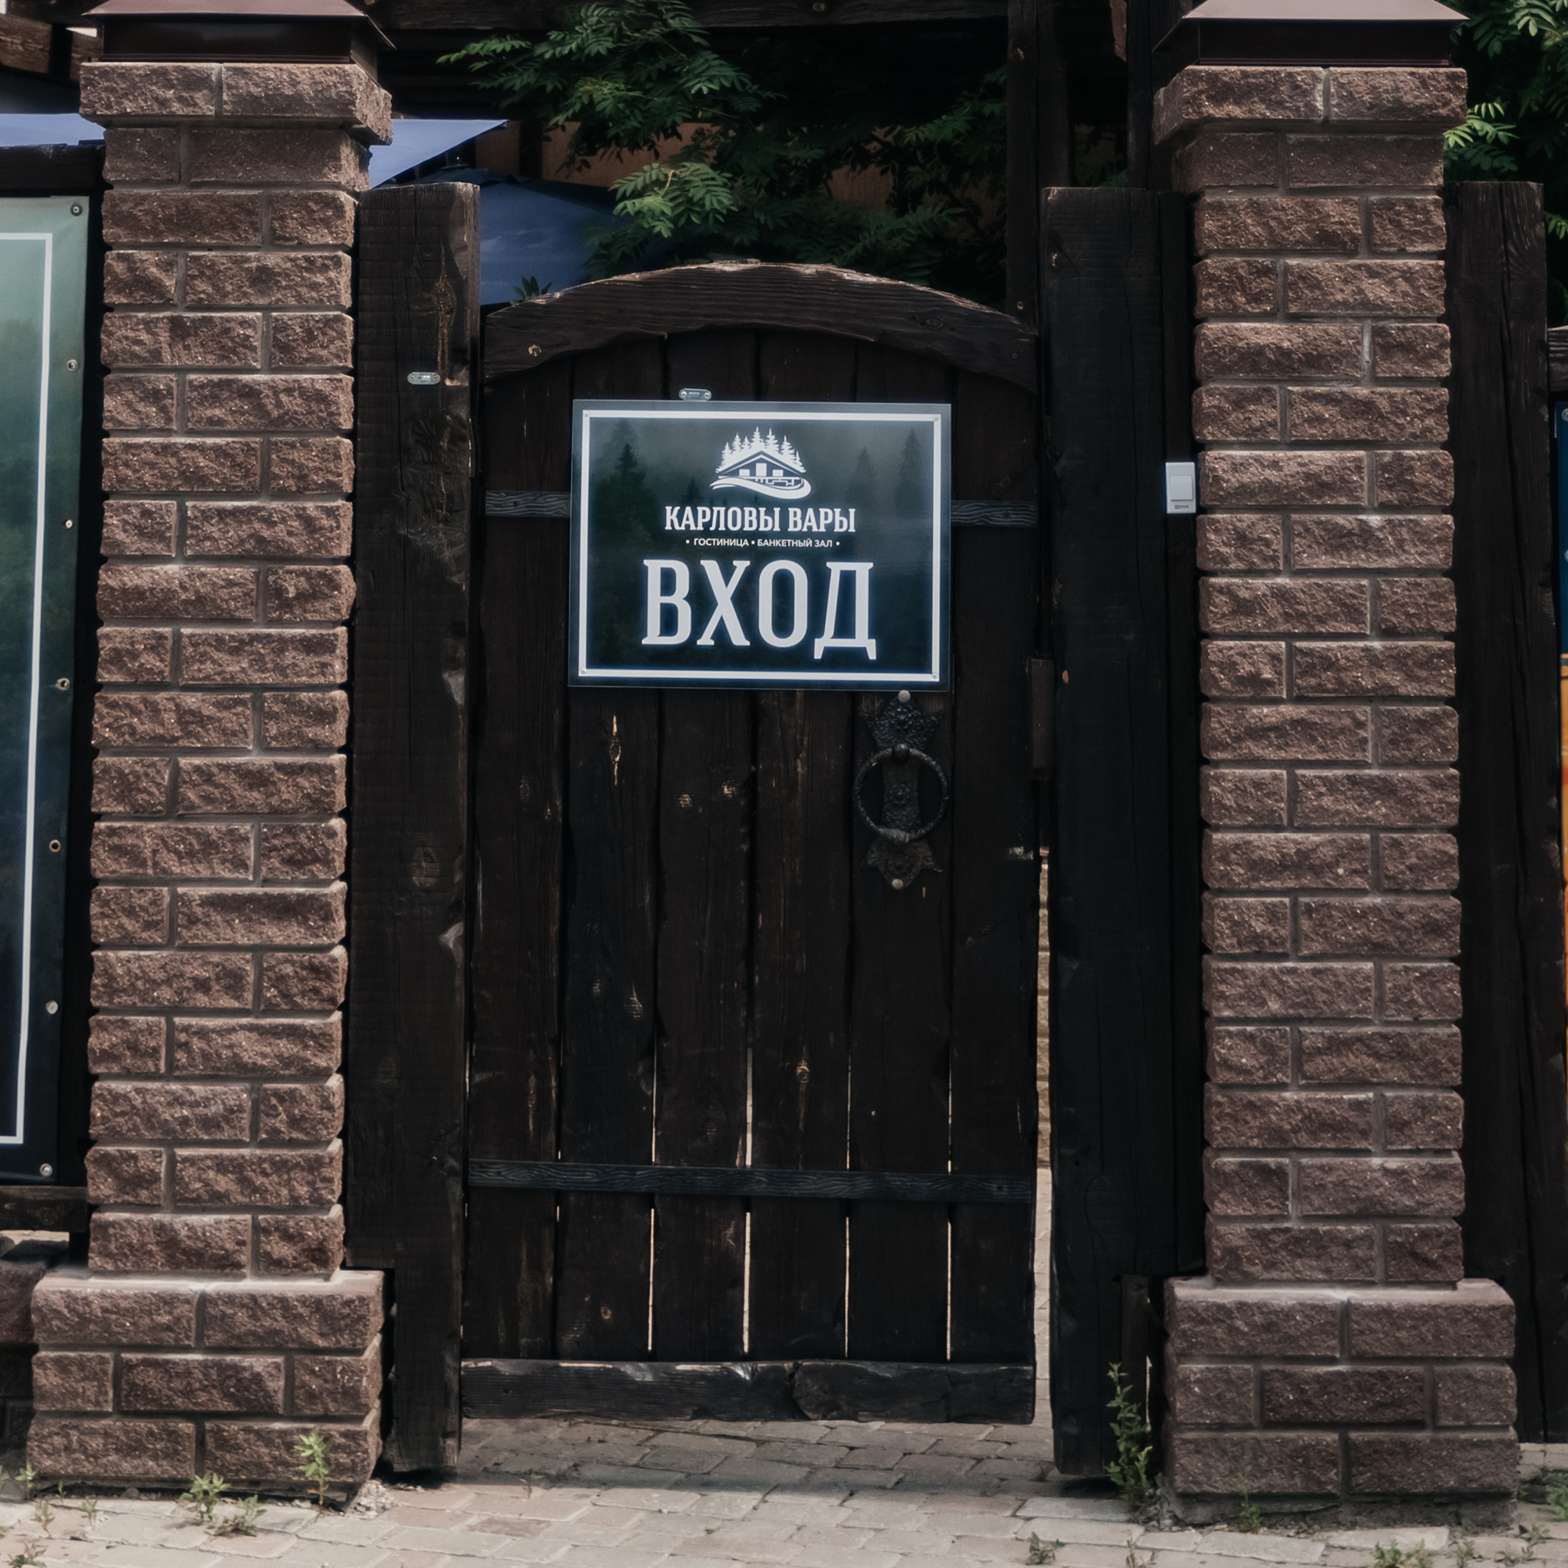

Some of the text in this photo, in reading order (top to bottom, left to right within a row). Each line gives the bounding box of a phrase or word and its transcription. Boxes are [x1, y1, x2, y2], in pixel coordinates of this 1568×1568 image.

[665, 506, 856, 533] КАРЛОВЫ ВАРЫ
[694, 538, 833, 548] ГОСТИНИЦА БАНКЕТНЫЙ ЗАЛ
[642, 559, 877, 660] ВХОД
